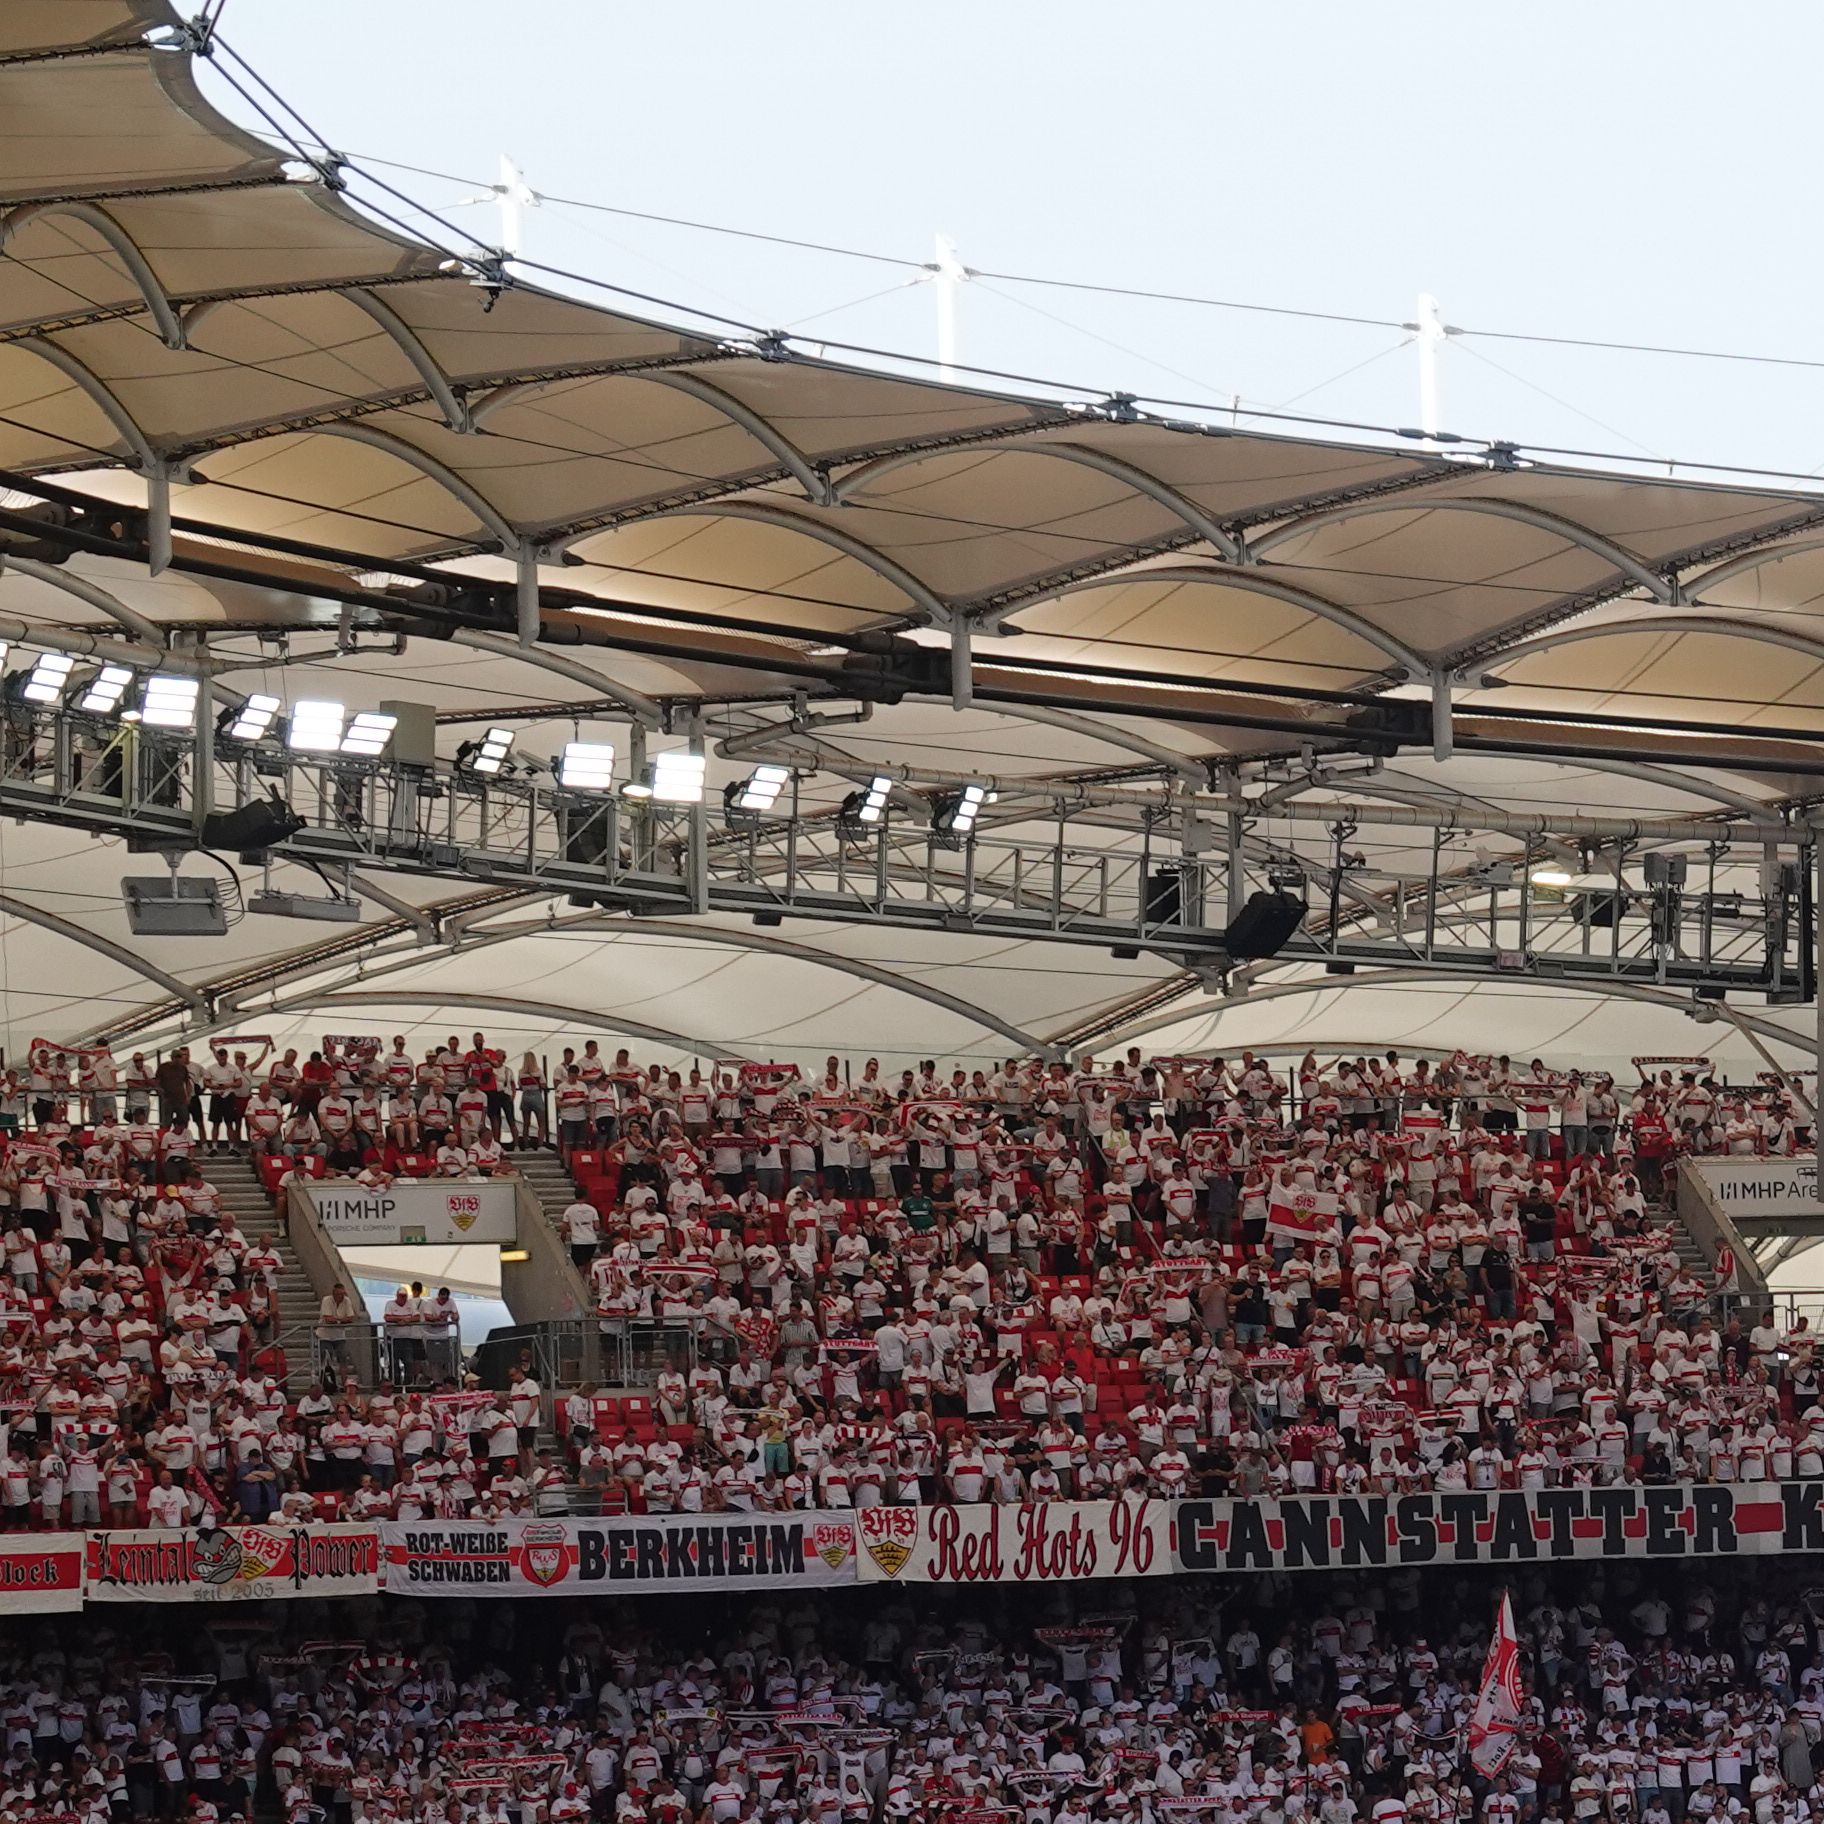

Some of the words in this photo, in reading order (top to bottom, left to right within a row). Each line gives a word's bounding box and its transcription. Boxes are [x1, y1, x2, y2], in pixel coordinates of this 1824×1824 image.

[1742, 1181, 1786, 1199] MHP
[345, 1199, 396, 1219] MHP
[577, 1523, 806, 1581] BERKHEIM
[927, 1503, 1004, 1581] Red
[1013, 1502, 1098, 1581] Hots
[1109, 1498, 1154, 1576] 96
[289, 1528, 372, 1591] Power
[407, 1557, 511, 1583] SCHWABEN
[230, 1583, 275, 1599] 2005
